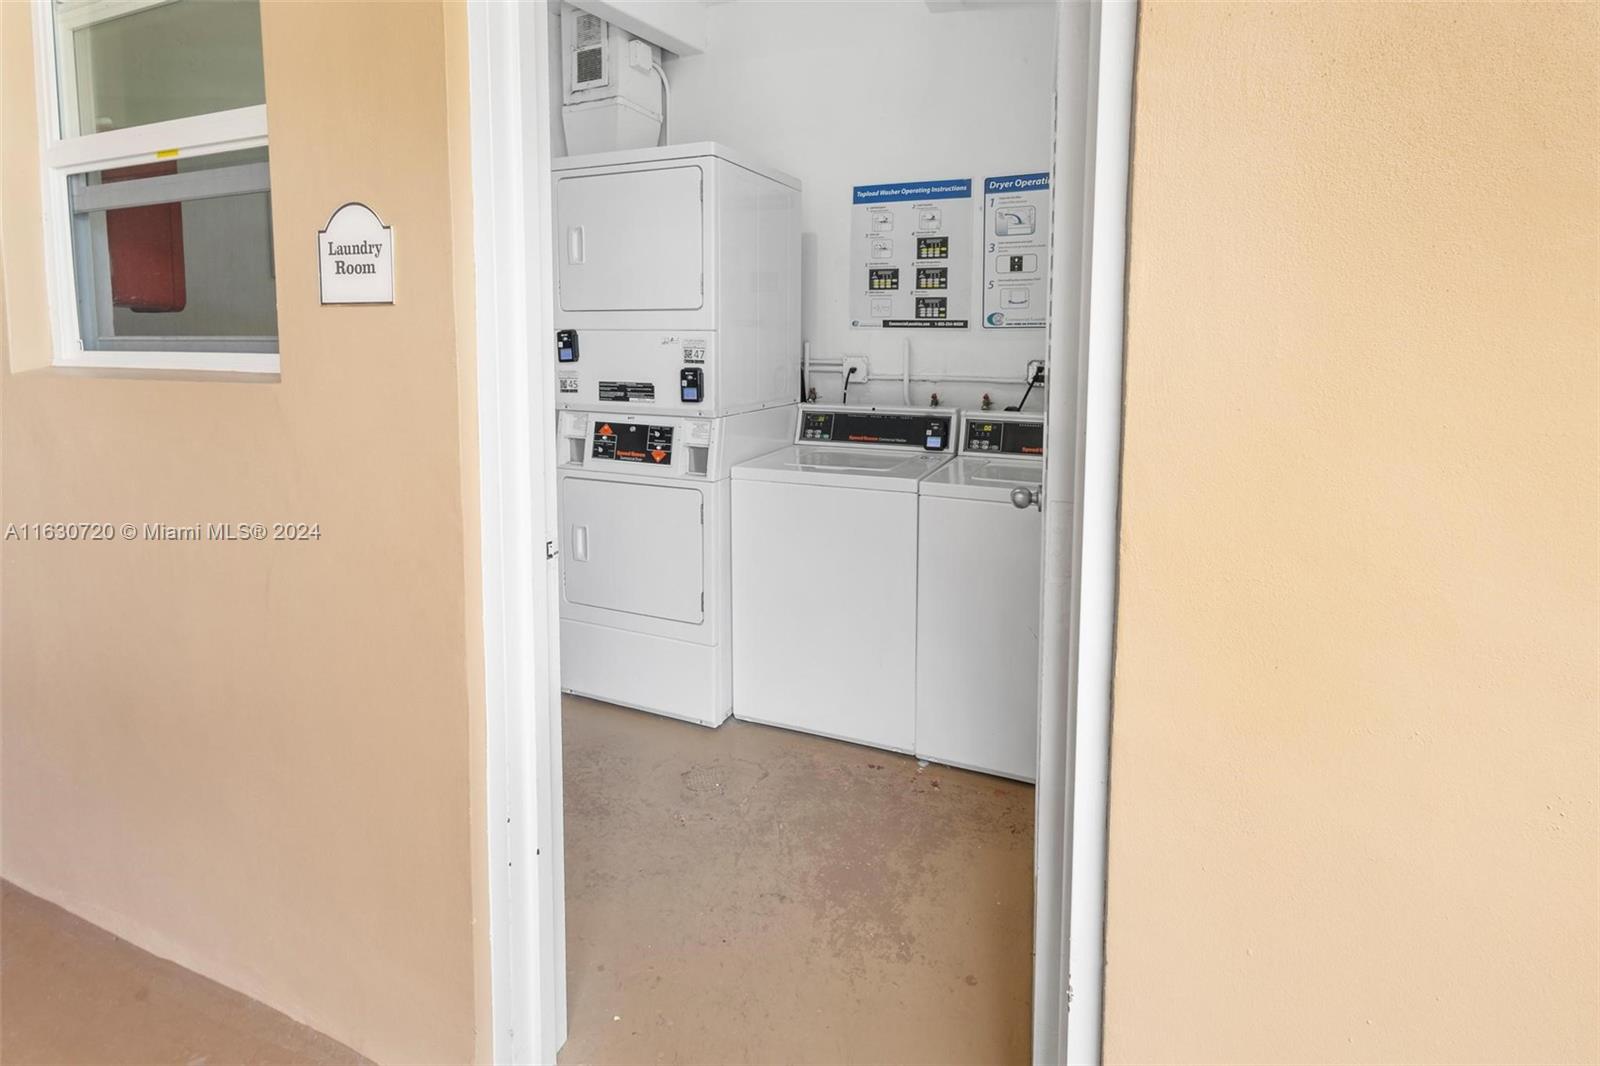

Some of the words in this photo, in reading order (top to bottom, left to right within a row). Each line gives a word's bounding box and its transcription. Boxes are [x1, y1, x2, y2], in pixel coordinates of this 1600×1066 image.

[989, 181, 1013, 190] Dryer
[1014, 176, 1049, 188] Operati
[857, 190, 879, 198] Topload
[901, 187, 930, 195] Operating
[931, 184, 967, 193] Instructions
[990, 198, 995, 208] 1
[328, 240, 382, 258] Laundry
[988, 242, 995, 253] 3
[335, 260, 376, 275] Room
[987, 280, 995, 290] 5
[694, 350, 705, 359] 47
[568, 380, 578, 389] 45
